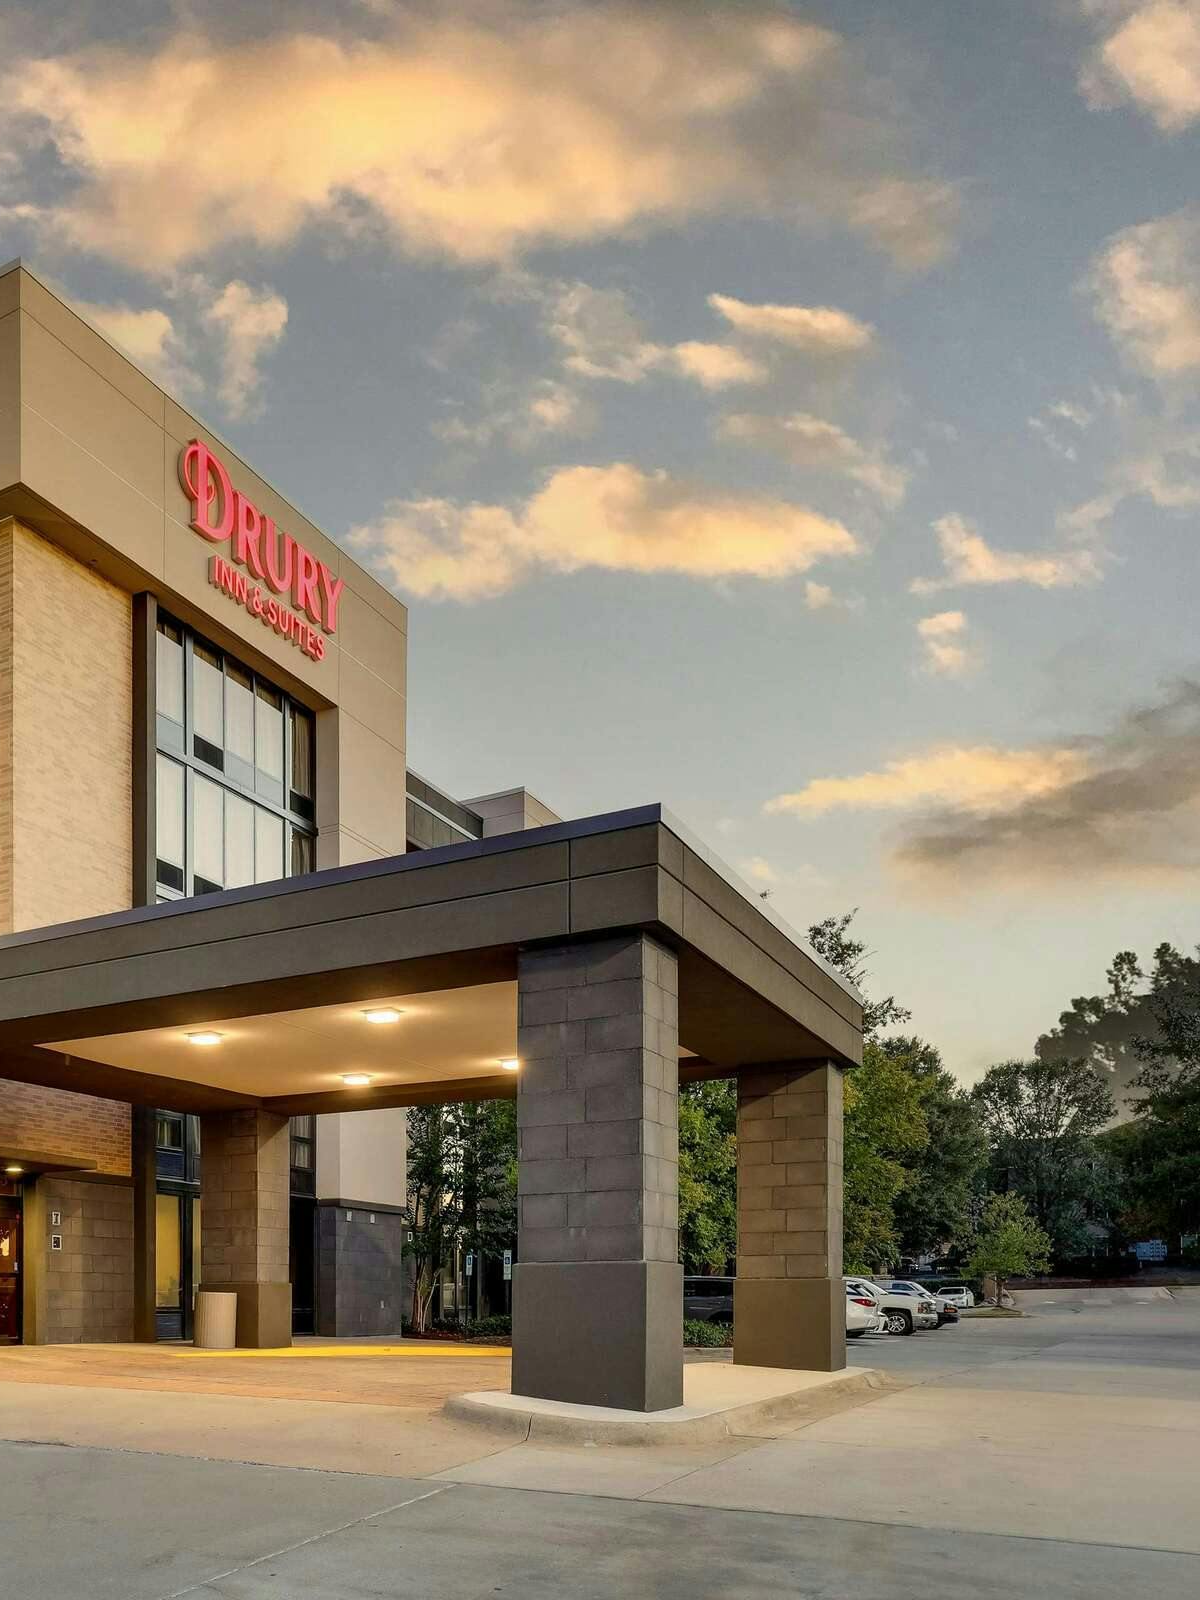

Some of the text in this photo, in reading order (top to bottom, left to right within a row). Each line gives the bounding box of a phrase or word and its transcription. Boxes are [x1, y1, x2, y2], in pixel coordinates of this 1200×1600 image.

[179, 438, 345, 634] DRURY
[210, 555, 326, 661] INN & SUITES
